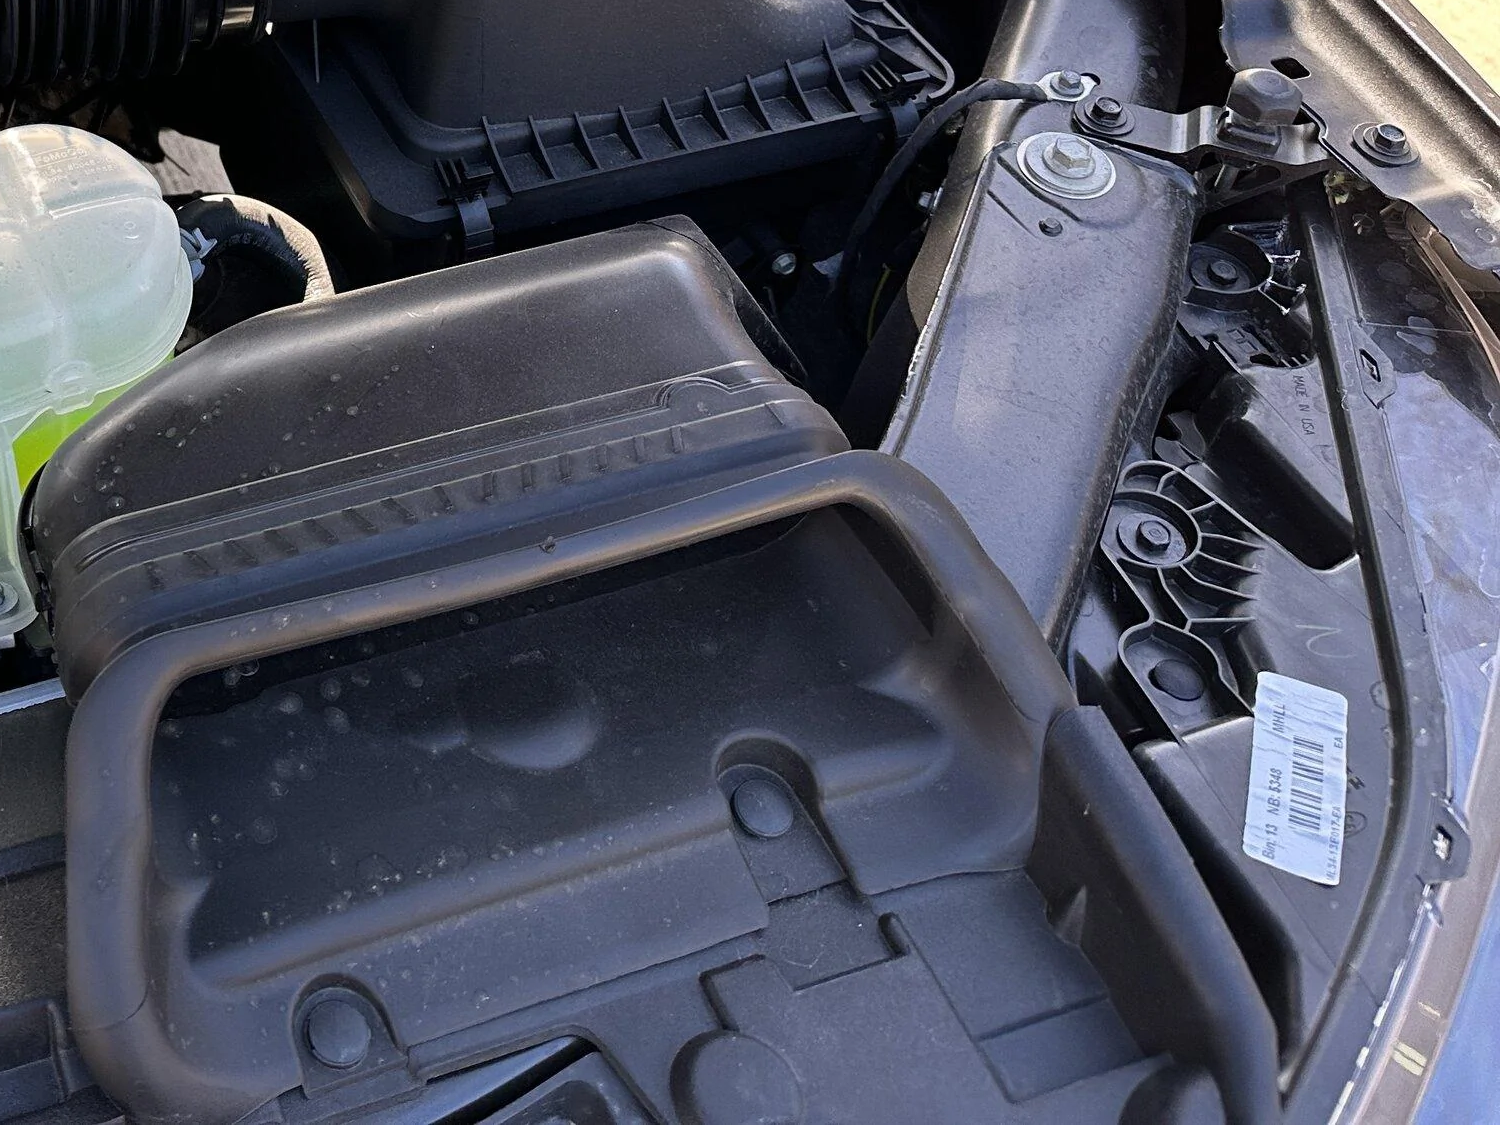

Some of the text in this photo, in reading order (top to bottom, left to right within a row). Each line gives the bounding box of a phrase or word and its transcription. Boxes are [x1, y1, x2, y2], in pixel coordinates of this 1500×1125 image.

[1262, 703, 1286, 861] Bin: 13 NB: 5348 MHLL
[1334, 736, 1344, 749] EA
